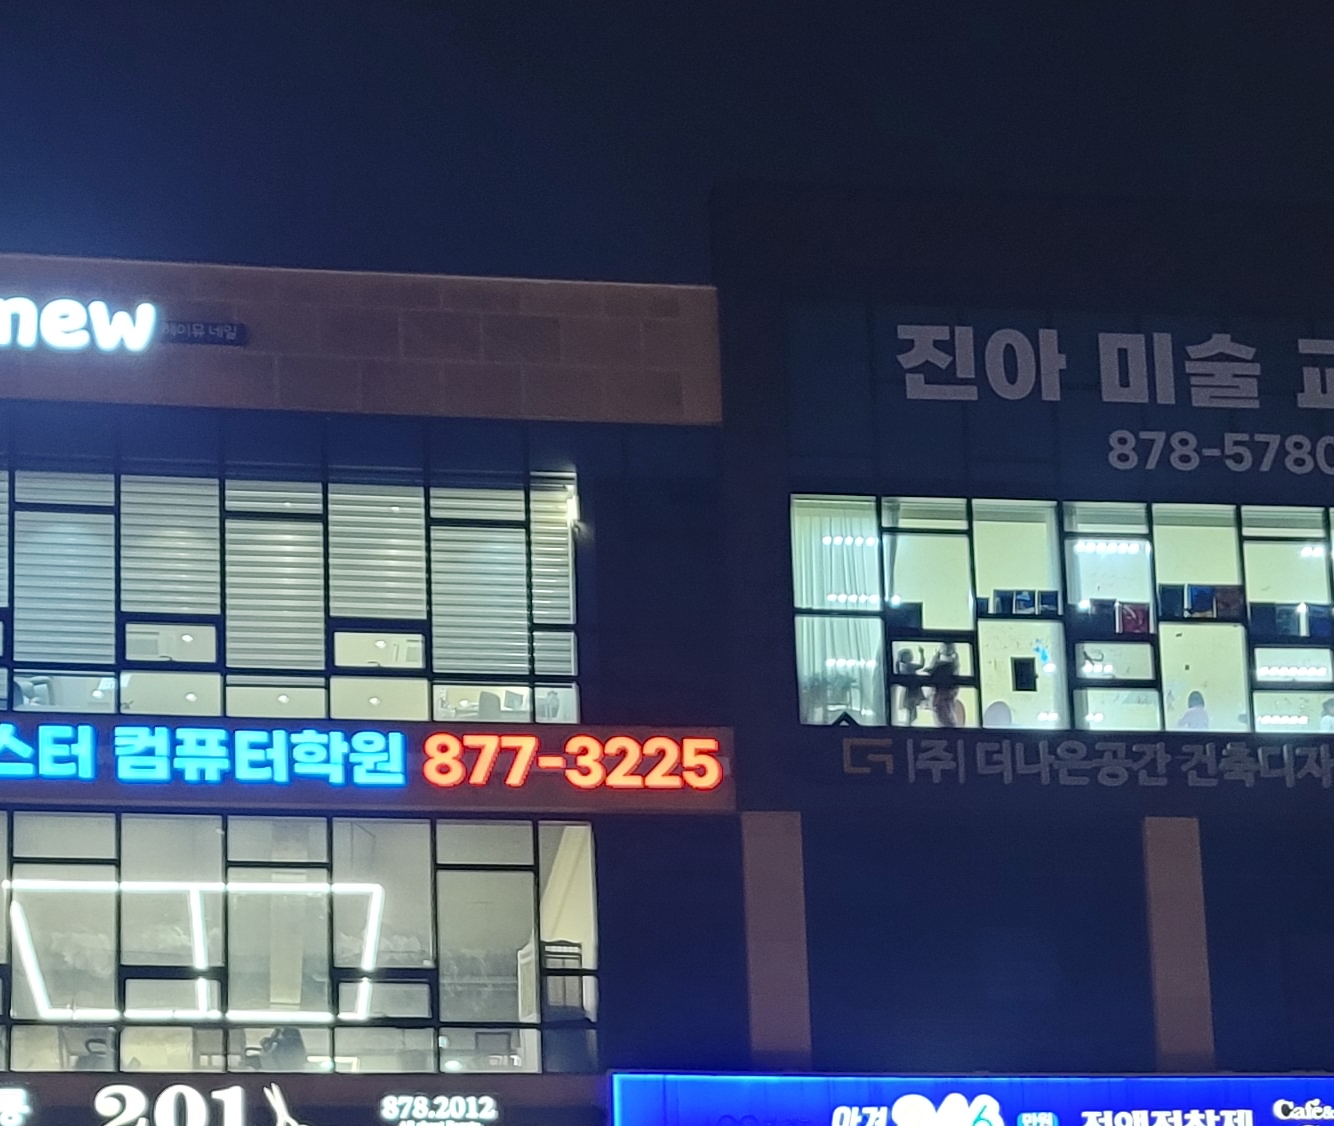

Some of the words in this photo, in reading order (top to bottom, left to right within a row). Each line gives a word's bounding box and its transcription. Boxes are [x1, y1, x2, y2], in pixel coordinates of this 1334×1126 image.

[208, 324, 237, 340] 네일
[896, 324, 1067, 401] 진아
[1098, 332, 1262, 410] 미술
[112, 723, 408, 787] 컴퓨터학원
[422, 730, 724, 790] 877-3225
[380, 1094, 499, 1120] 878.2012
